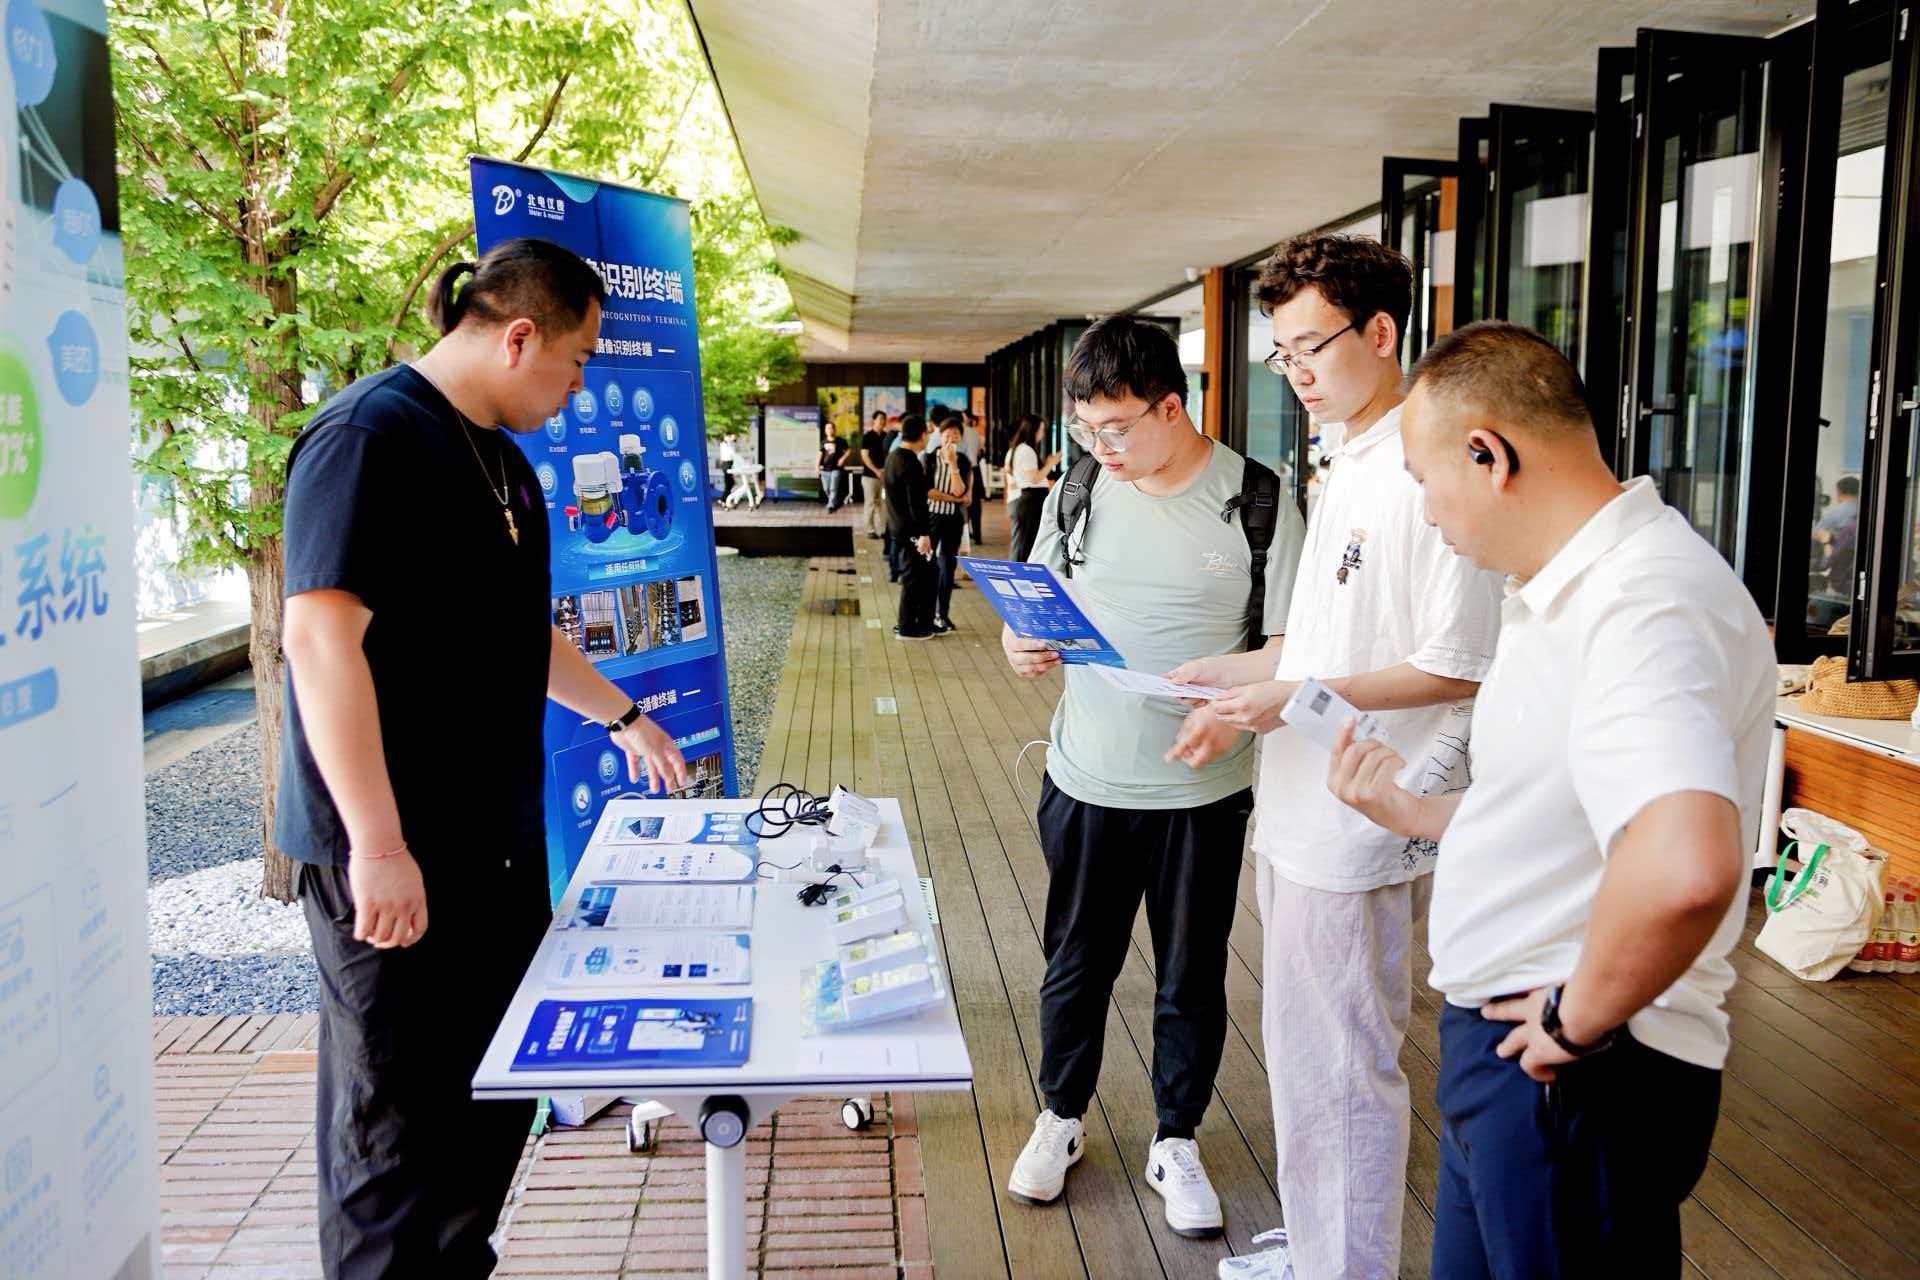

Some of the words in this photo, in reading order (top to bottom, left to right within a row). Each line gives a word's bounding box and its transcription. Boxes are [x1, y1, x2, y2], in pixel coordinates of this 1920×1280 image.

[586, 258, 684, 305] 识别终端
[601, 310, 652, 323] RECOGNITION
[655, 315, 688, 326] TERMINAL
[0, 523, 109, 646] 系统
